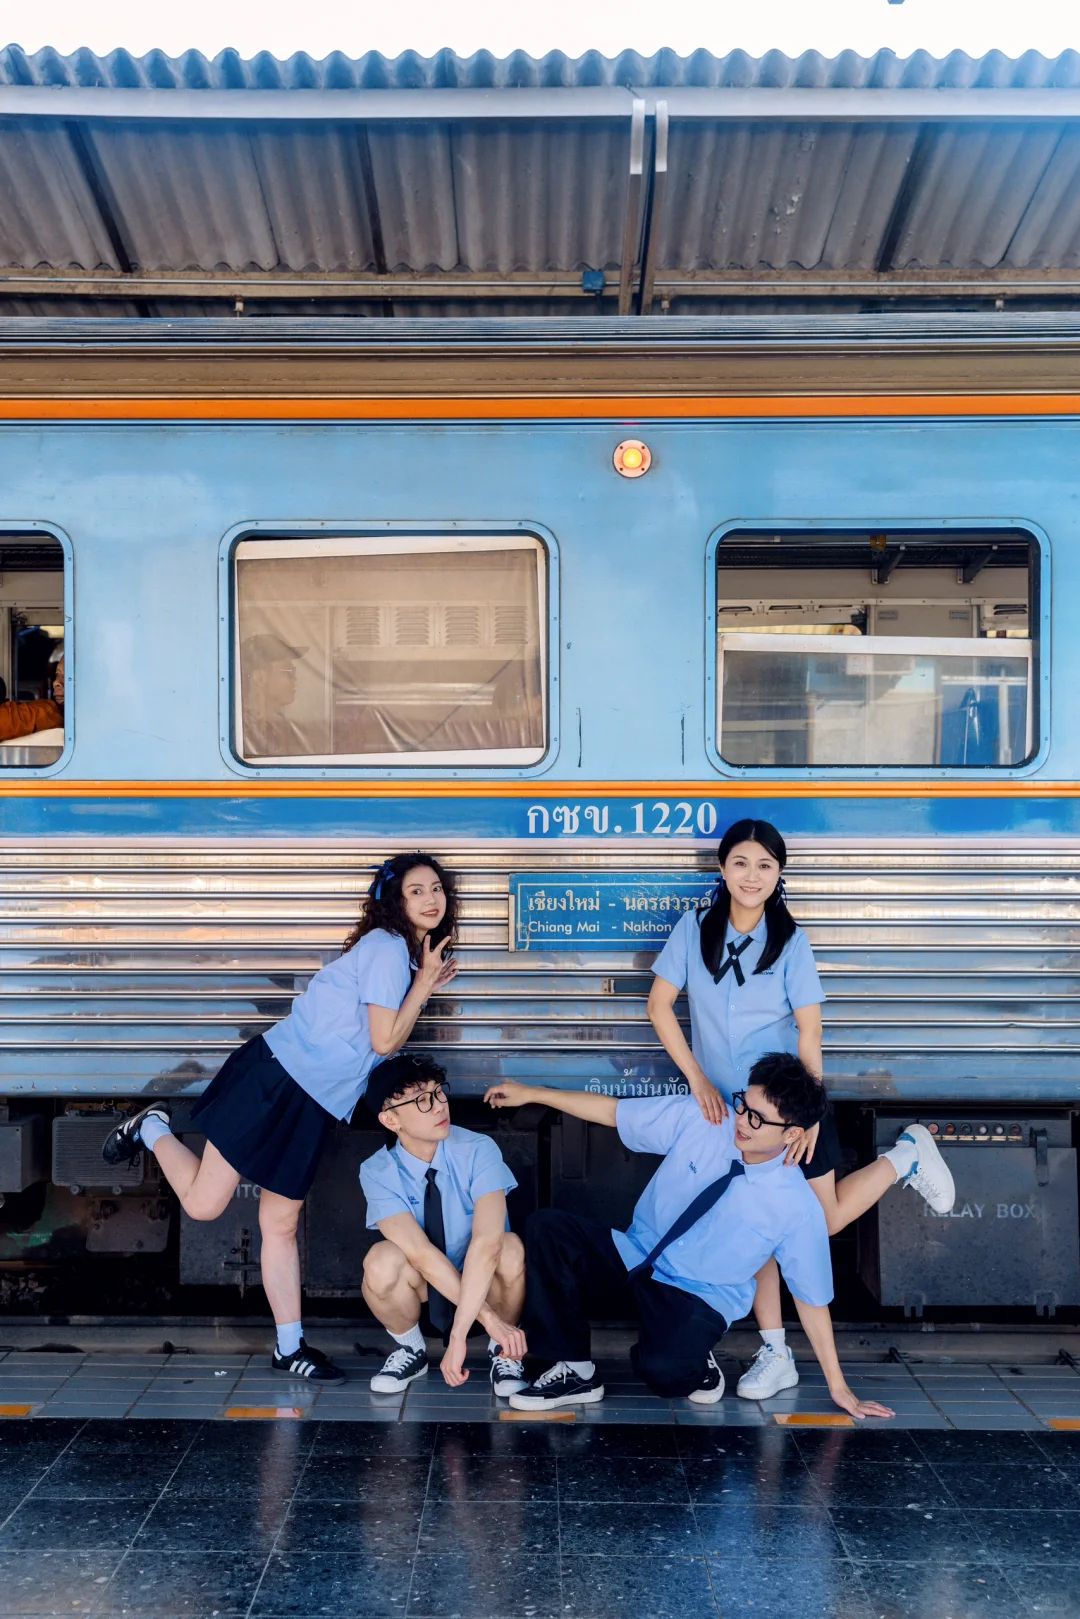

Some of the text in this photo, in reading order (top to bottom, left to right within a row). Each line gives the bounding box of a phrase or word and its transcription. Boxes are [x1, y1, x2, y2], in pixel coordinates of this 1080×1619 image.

[527, 802, 717, 835] กซข. 1220
[527, 889, 600, 912] เชียงใหม่
[528, 921, 572, 934] Chiang
[577, 921, 600, 932] Mai
[623, 920, 672, 932] Nakhon
[584, 1068, 690, 1097] เติมน้ำมันพัด
[996, 1203, 1036, 1218] BOX
